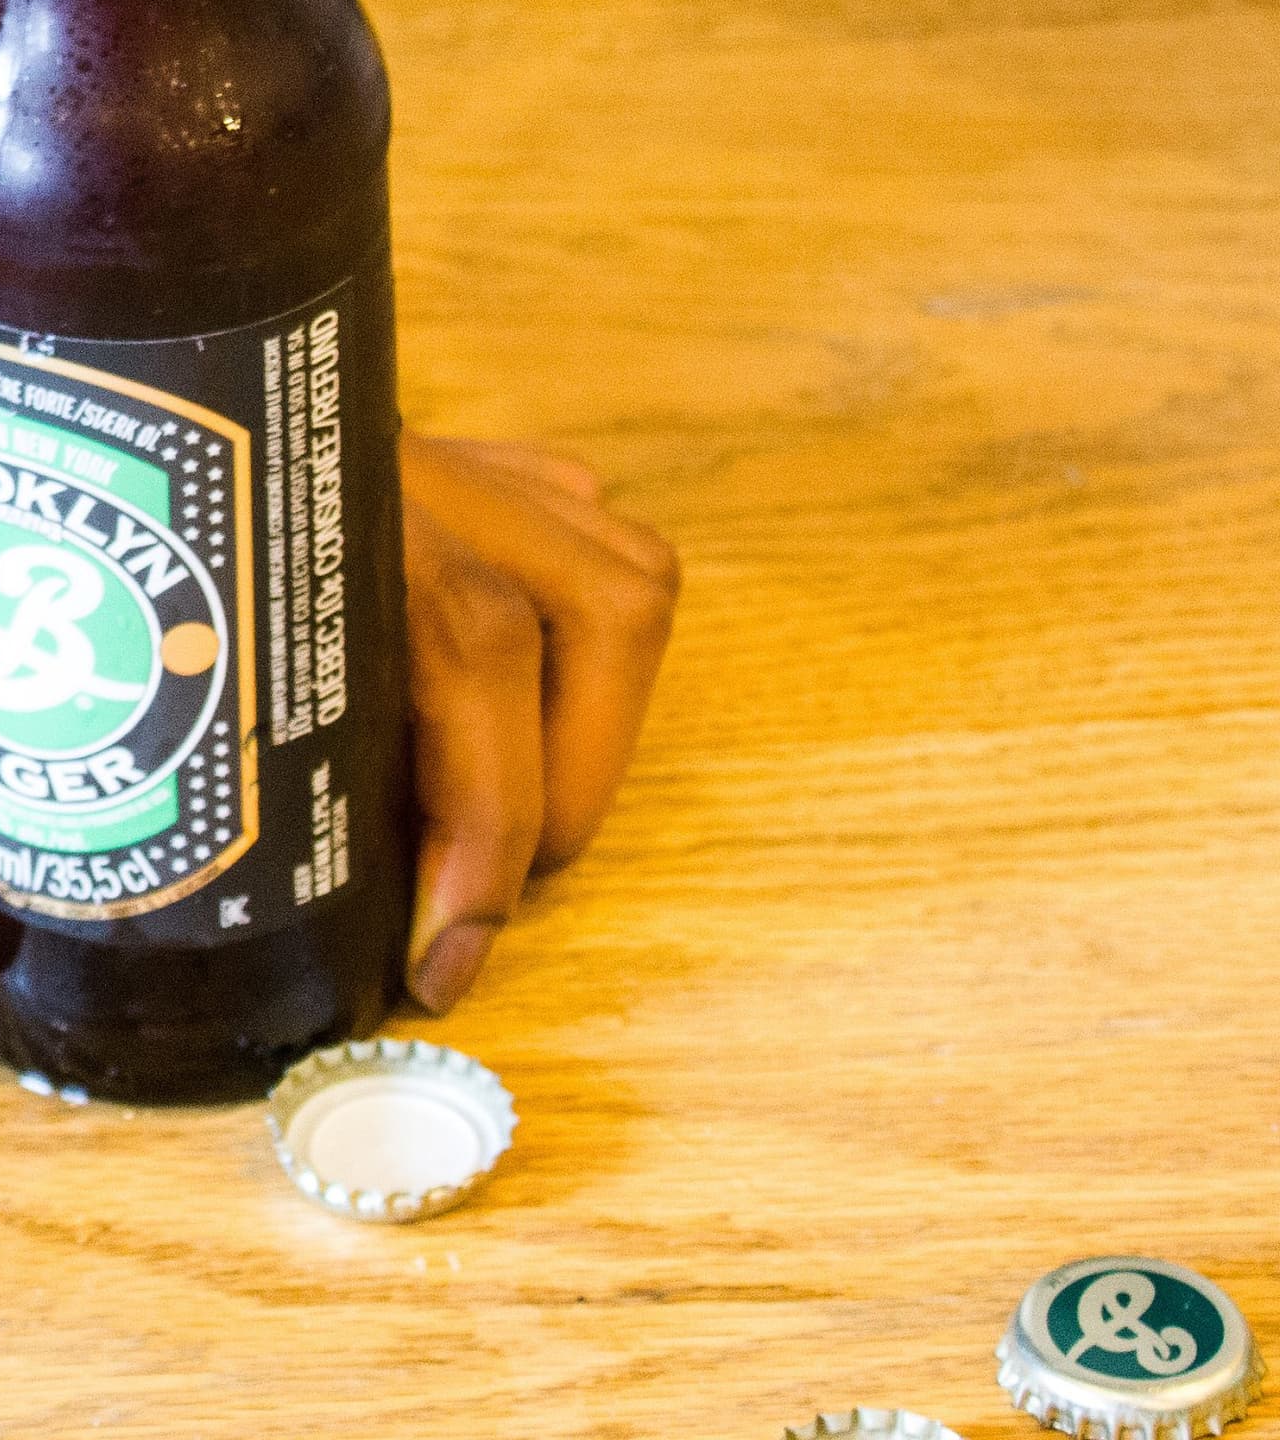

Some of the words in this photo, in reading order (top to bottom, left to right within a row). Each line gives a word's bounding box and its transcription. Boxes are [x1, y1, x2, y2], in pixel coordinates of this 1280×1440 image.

[288, 323, 305, 352] SA
[288, 350, 305, 373] IN
[288, 370, 306, 415] SOLD
[11, 428, 59, 465] NEW
[62, 443, 121, 486] YORK
[289, 412, 308, 461] WHEN
[306, 310, 344, 577] CONSIGNÉE/REFUND
[290, 458, 309, 533] DEPOSITS
[292, 529, 310, 624] COLLECTION
[293, 641, 311, 704] REFUND
[311, 617, 347, 727] QUÉBEC
